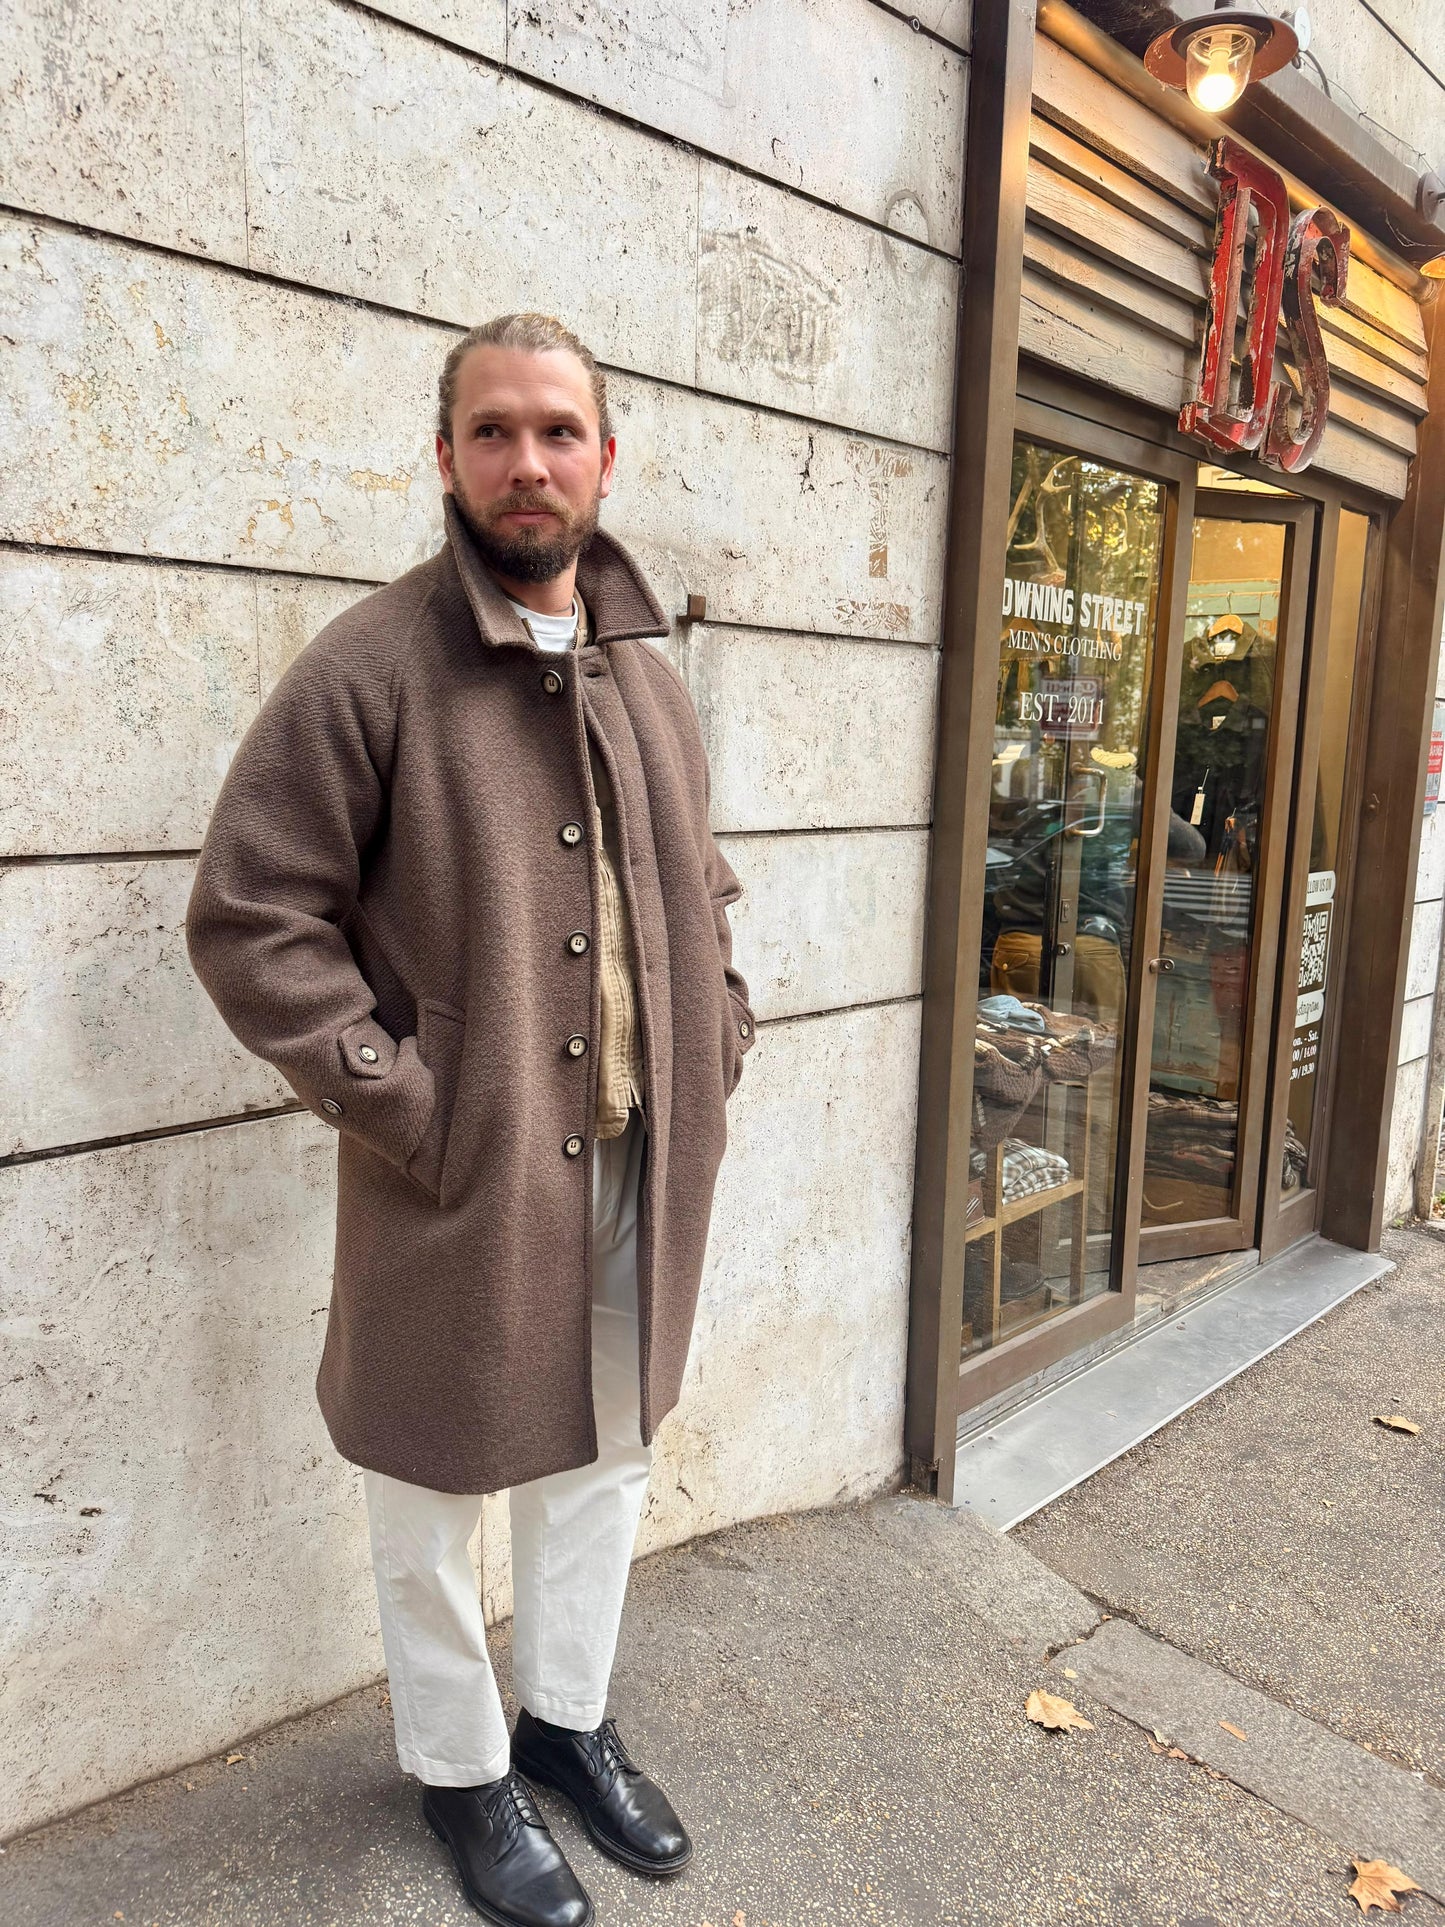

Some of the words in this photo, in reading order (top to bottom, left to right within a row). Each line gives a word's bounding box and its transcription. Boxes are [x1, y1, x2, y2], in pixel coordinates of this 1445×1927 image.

[1079, 592, 1145, 635] STREET
[1008, 628, 1051, 653] MEN'S
[1054, 634, 1122, 661] CLOTHING
[1018, 691, 1062, 722] EST.
[1067, 696, 1104, 725] 2011
[1296, 1001, 1319, 1022] stagram
[1308, 1030, 1319, 1042] Sat.
